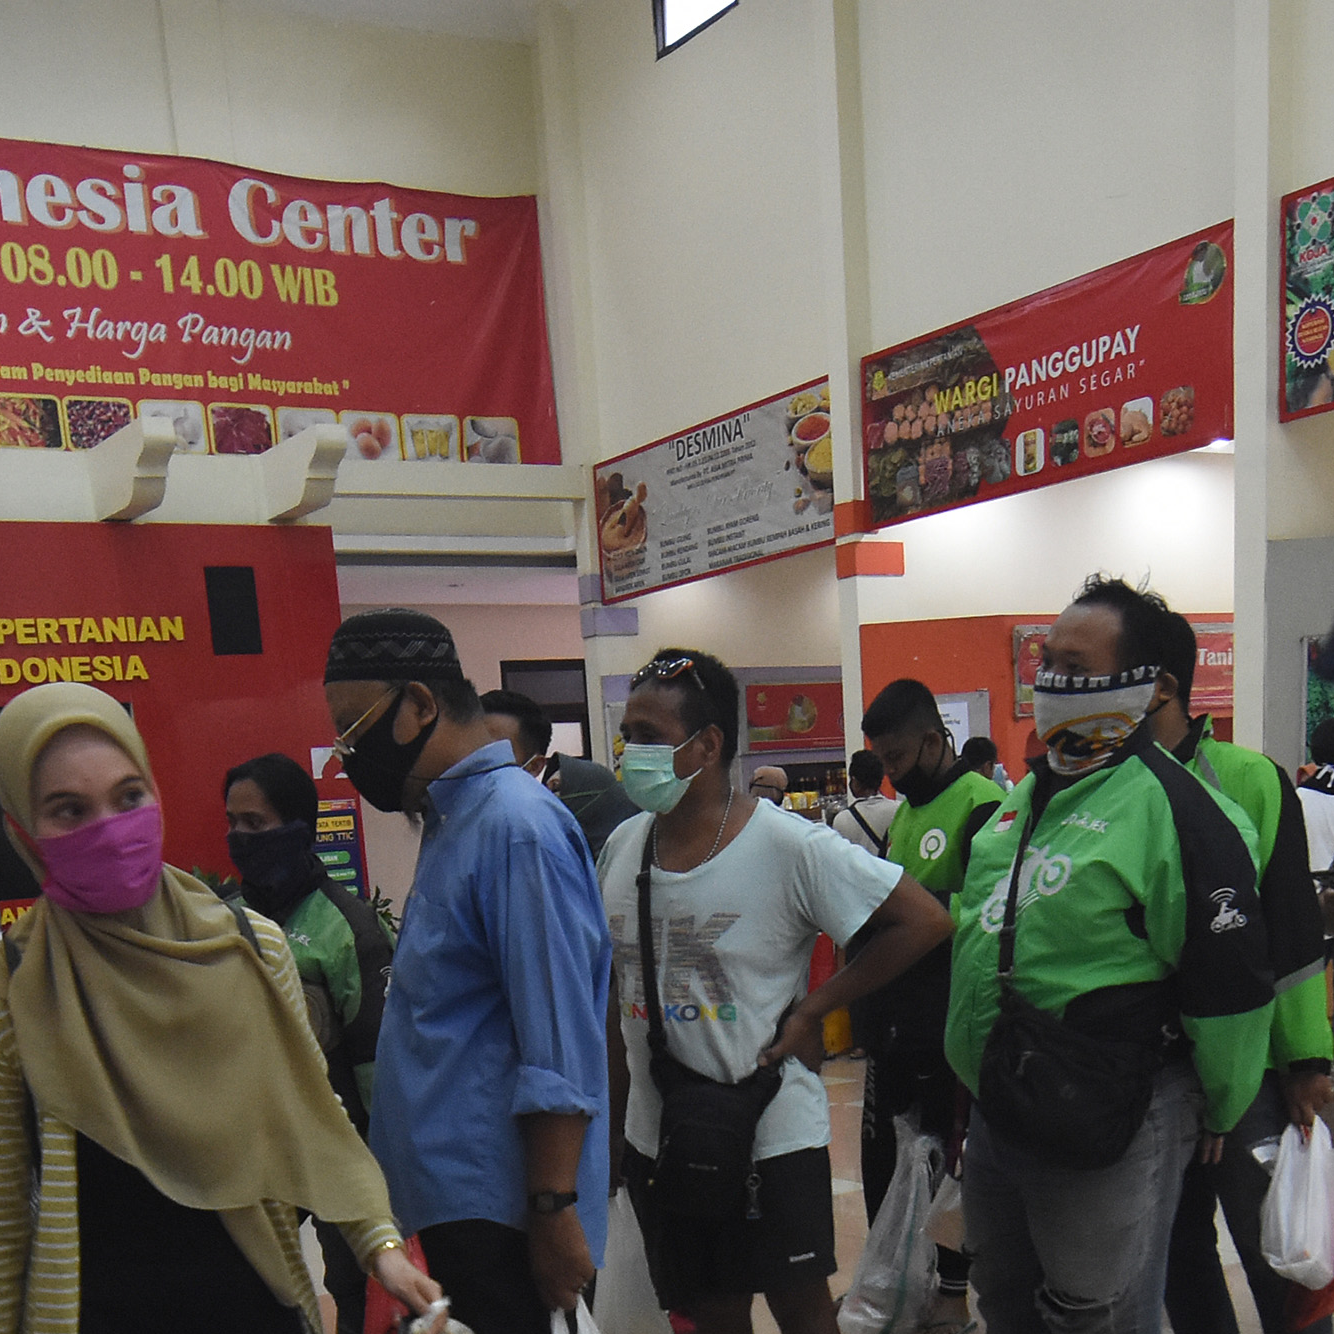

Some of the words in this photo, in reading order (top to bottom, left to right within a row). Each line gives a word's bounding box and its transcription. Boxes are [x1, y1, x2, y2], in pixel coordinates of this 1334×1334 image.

[227, 177, 477, 263] Center
[0, 240, 119, 291] 08.00
[155, 254, 264, 300] 14.00
[269, 263, 340, 307] WIB
[18, 307, 54, 343] &
[62, 306, 167, 359] Harga
[178, 311, 293, 365] Pangan
[32, 362, 136, 387] Penyediaan
[138, 367, 205, 391] Pangan
[208, 370, 245, 392] bagi
[247, 372, 340, 396] Masyarakat
[933, 372, 999, 415] WARGI
[1004, 323, 1141, 394] PANGGUPAY
[993, 384, 1070, 420] SAYURAN
[1197, 648, 1233, 666] Tani
[663, 1003, 738, 1023] KONG
